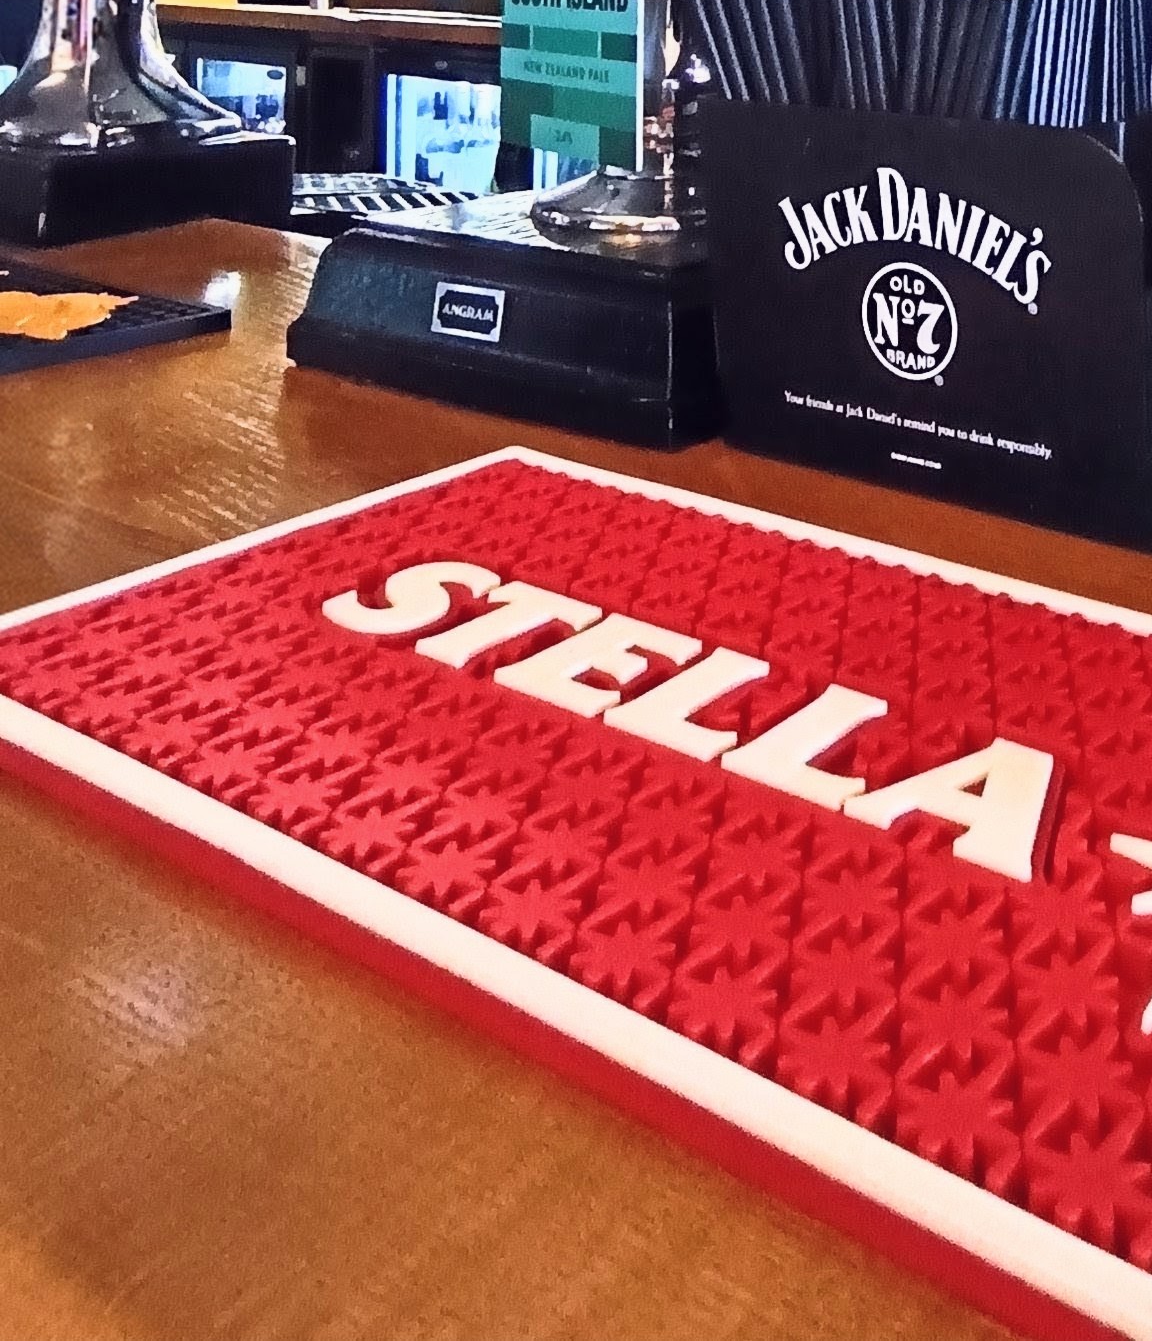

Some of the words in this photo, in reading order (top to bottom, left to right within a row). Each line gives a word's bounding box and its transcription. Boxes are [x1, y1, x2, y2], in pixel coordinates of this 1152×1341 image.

[545, 63, 586, 80] ZEALAND
[588, 69, 610, 84] PALE
[777, 184, 877, 270] JACK
[876, 167, 1052, 305] DANIEL'S
[889, 274, 925, 296] OLD
[442, 302, 494, 323] ANGRAM
[886, 348, 936, 371] BRAND
[784, 390, 804, 405] Your
[805, 395, 834, 413] friends
[846, 403, 863, 418] Jack
[903, 417, 936, 434] remind
[937, 424, 955, 438] you
[957, 429, 967, 440] to
[969, 430, 994, 446] drink
[322, 561, 1055, 884] STELLA
